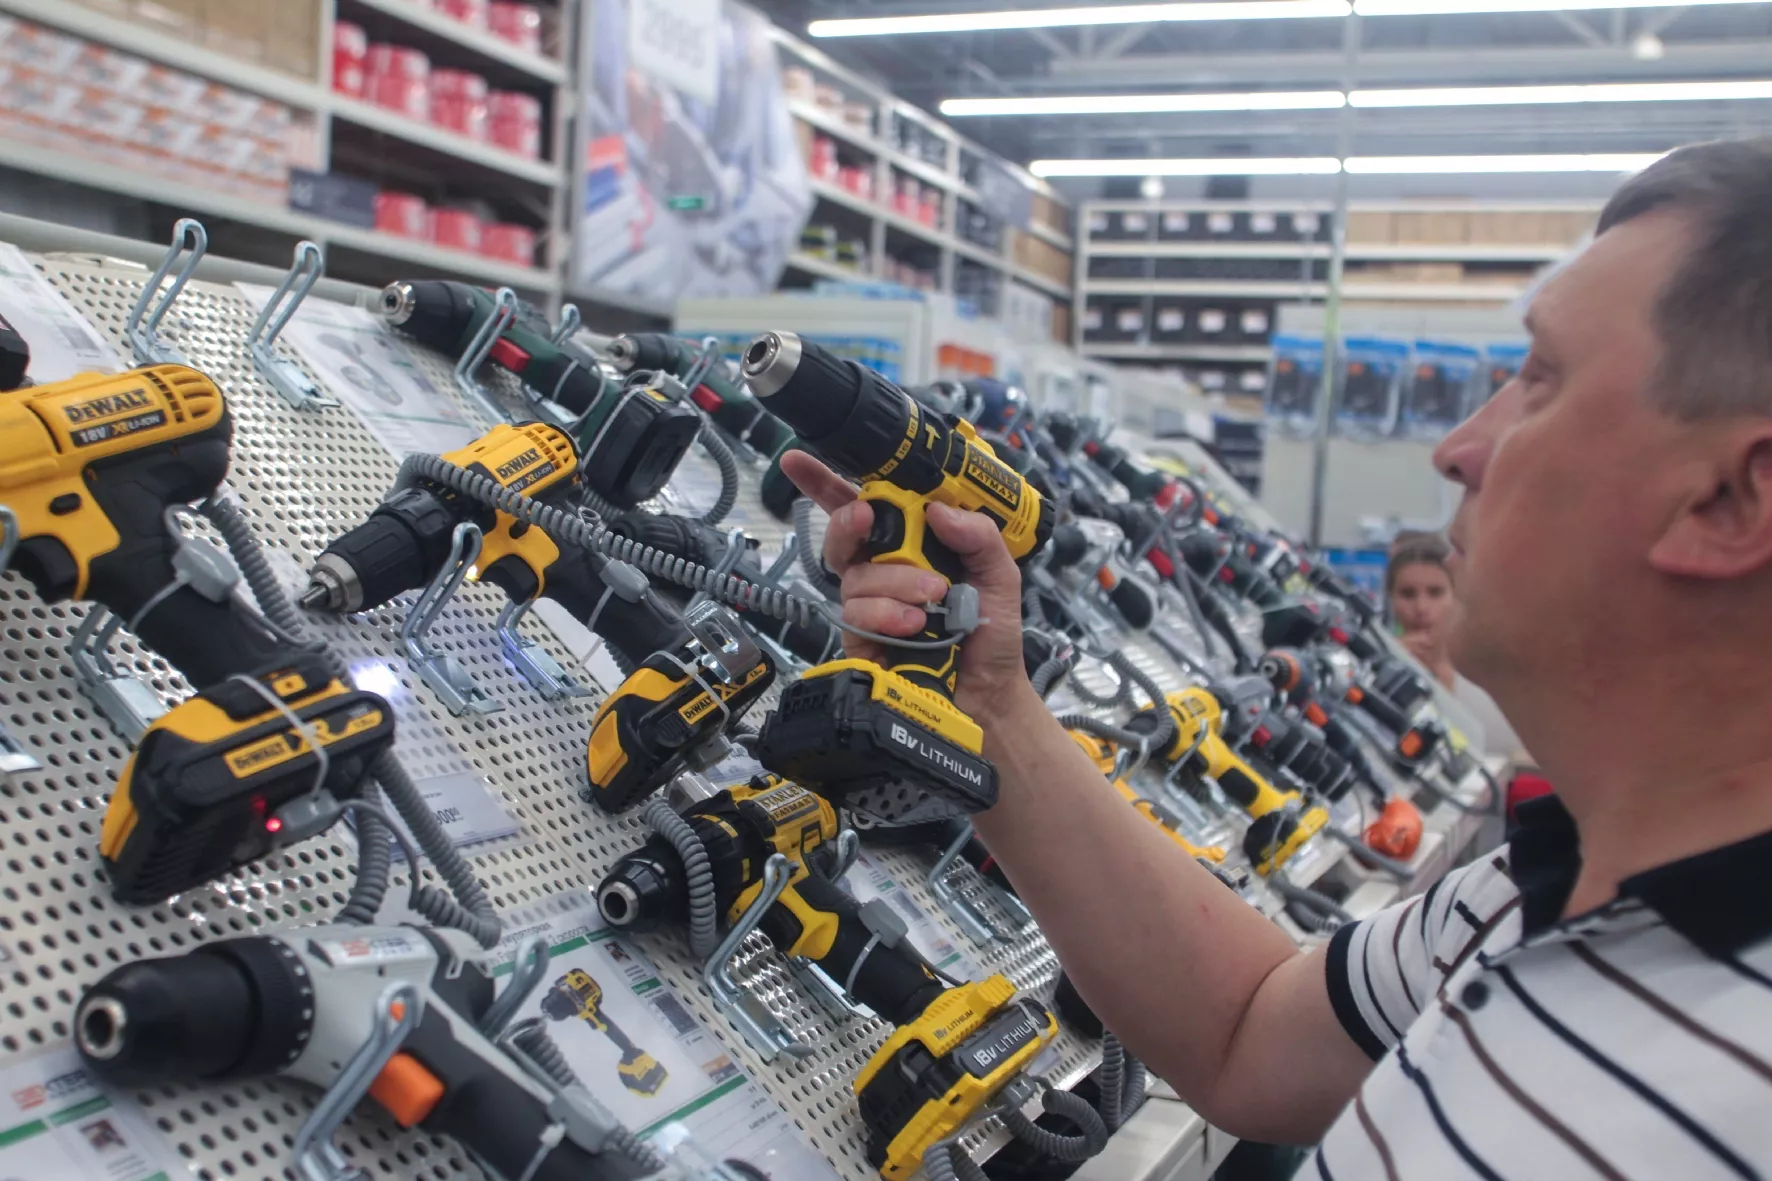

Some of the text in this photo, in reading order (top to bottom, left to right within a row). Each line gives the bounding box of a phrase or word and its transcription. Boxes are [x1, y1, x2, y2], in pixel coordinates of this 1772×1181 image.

[80, 426, 107, 443] 18V
[970, 449, 1019, 490] STANLEY
[971, 467, 1016, 503] FATMAX
[904, 699, 942, 724] LITHIUM
[920, 742, 982, 786] LITHIUM
[761, 785, 805, 809] STANLEY
[773, 797, 811, 818] FATMAX
[947, 1009, 974, 1031] LITHIUM
[995, 1017, 1041, 1053] LITHIUM
